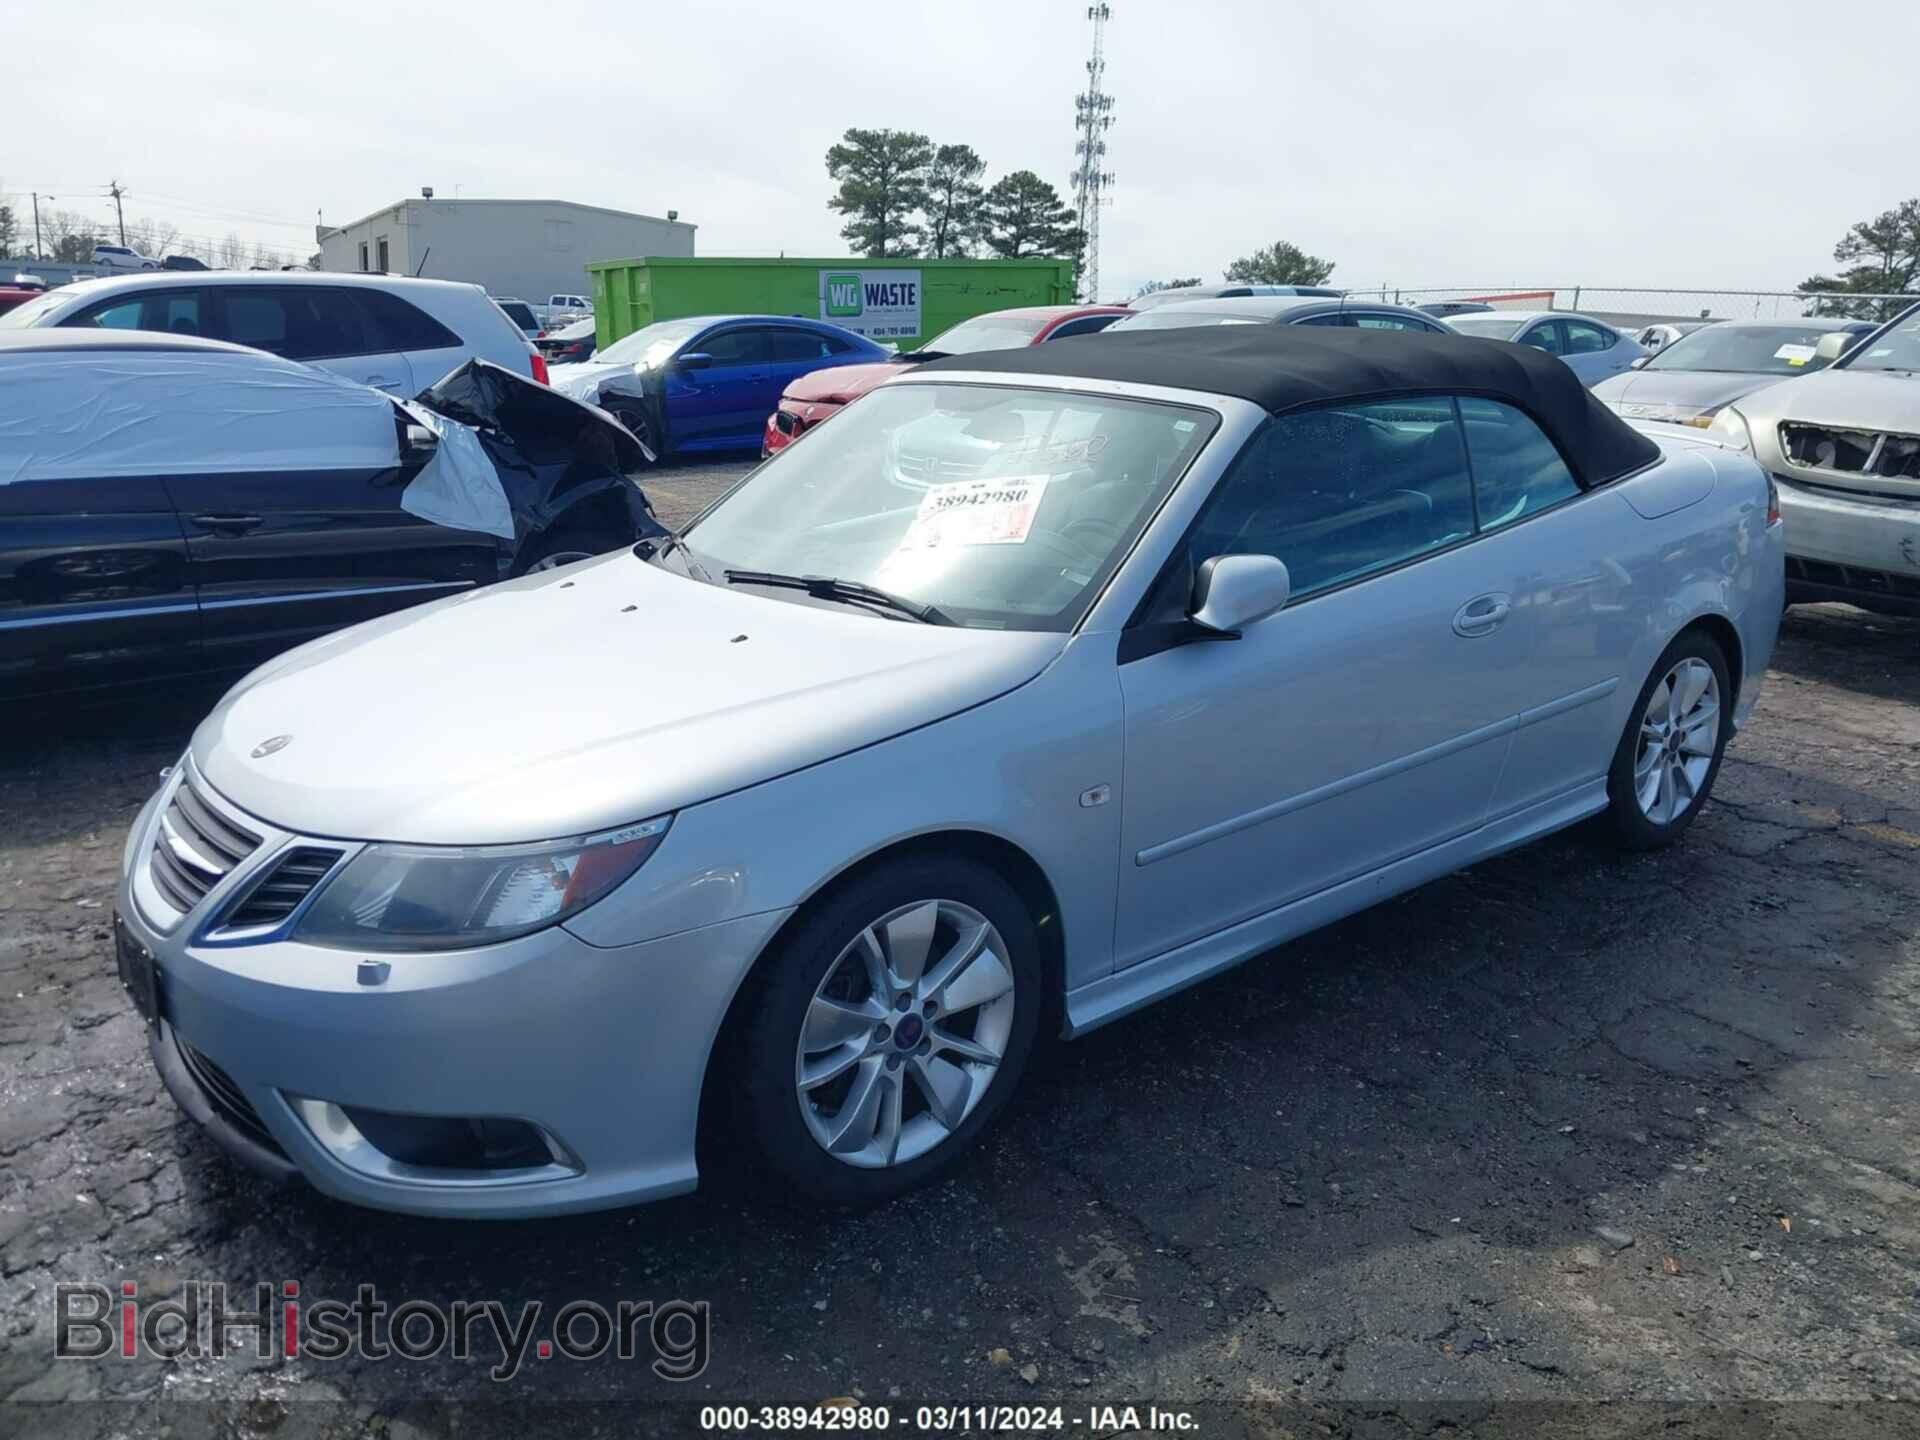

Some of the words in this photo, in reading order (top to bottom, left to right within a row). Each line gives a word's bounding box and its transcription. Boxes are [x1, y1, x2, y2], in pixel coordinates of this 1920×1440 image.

[831, 284, 857, 307] WG
[864, 283, 916, 306] WASTE
[936, 489, 1028, 508] 38942980
